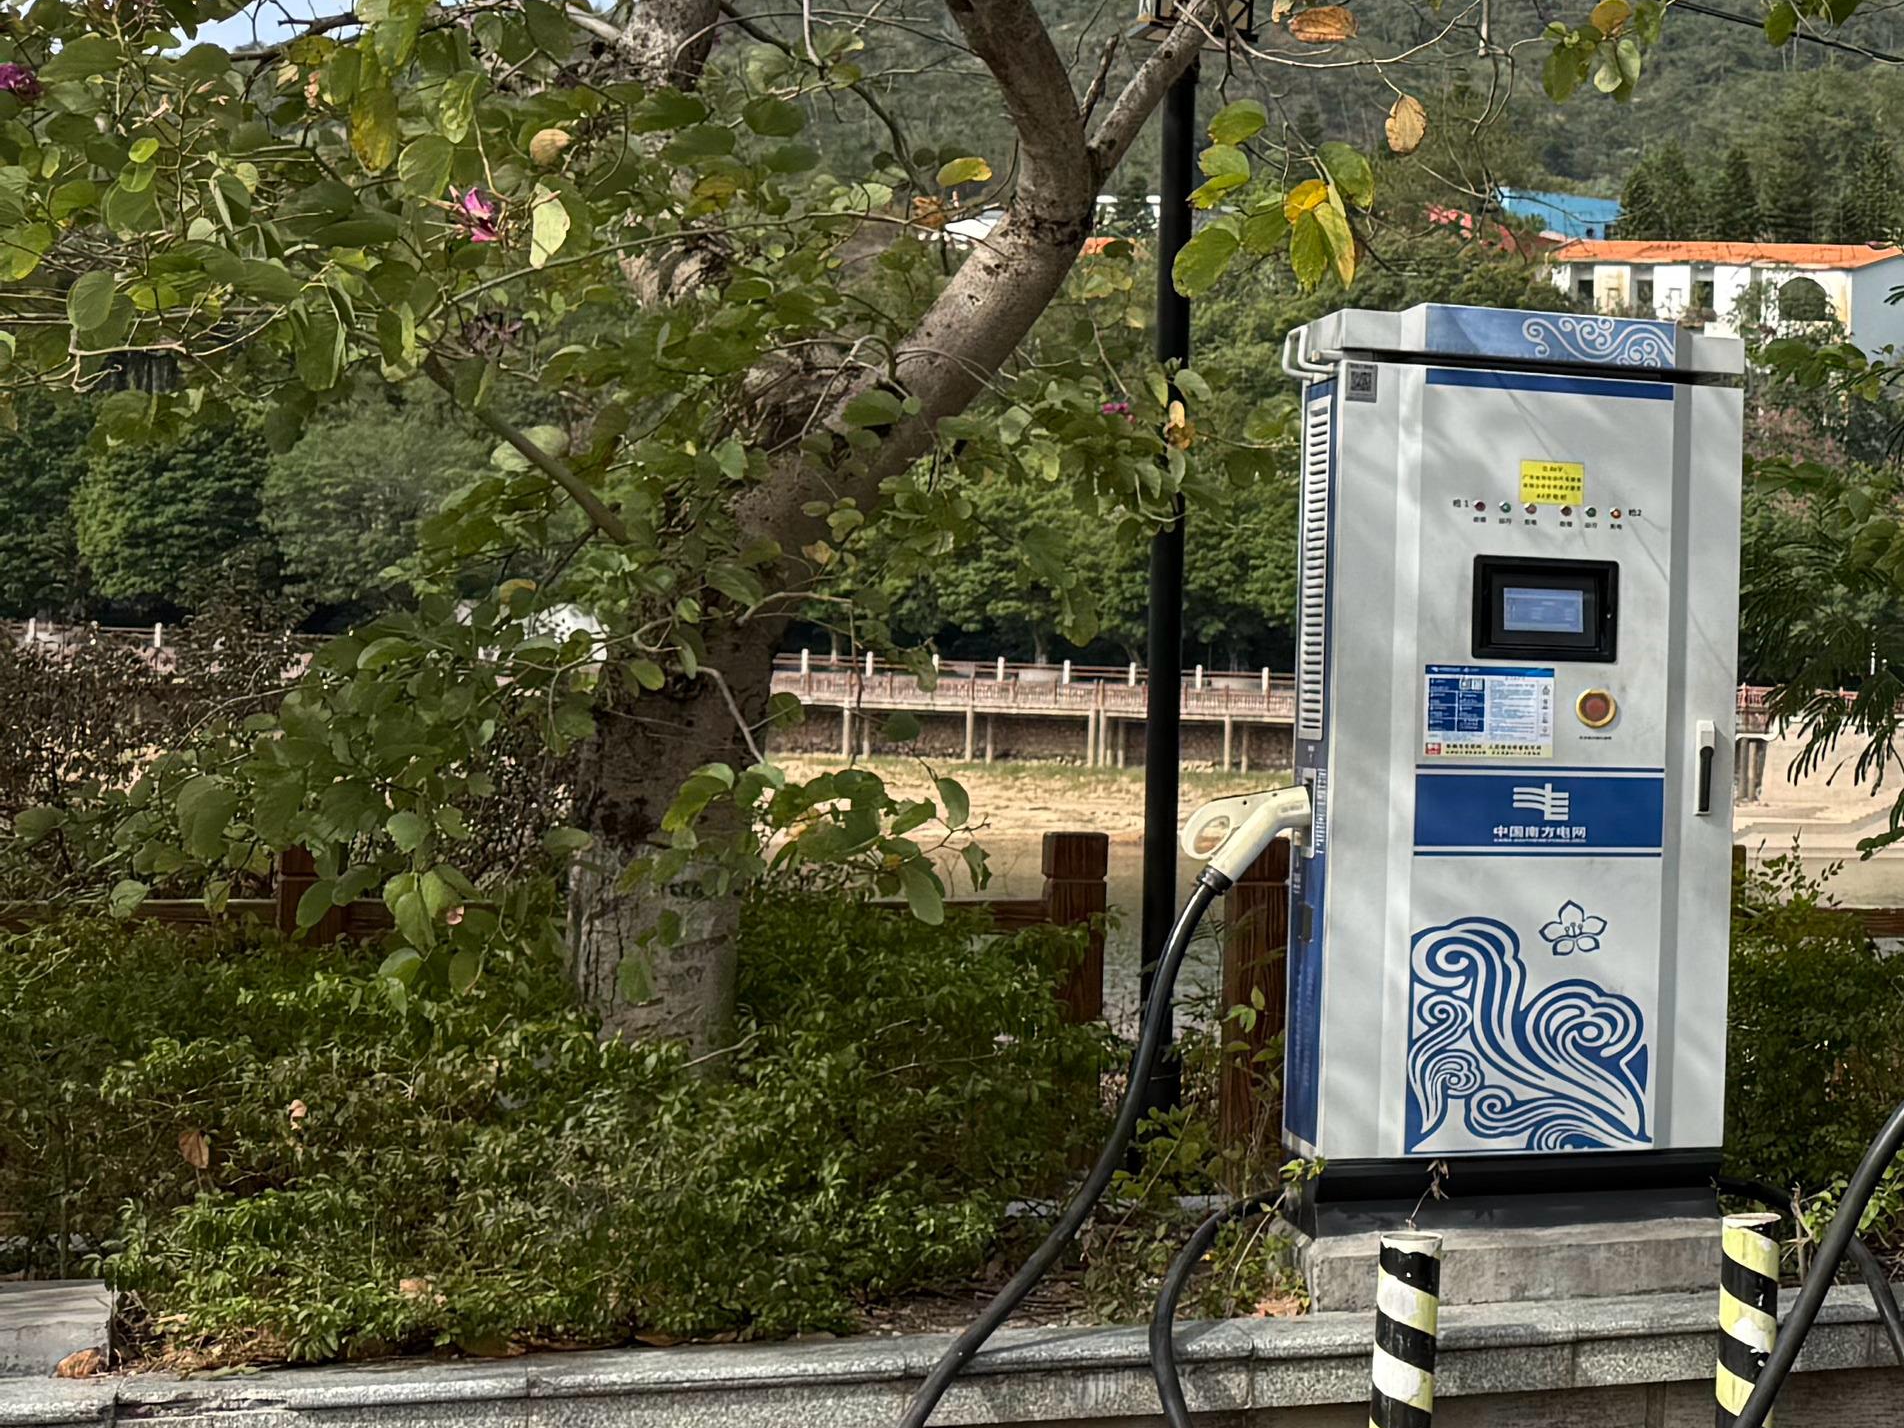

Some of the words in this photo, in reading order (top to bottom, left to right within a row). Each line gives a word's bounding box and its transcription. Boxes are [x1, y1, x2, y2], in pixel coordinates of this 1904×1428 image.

[1493, 825, 1586, 838] 中国南方电网
